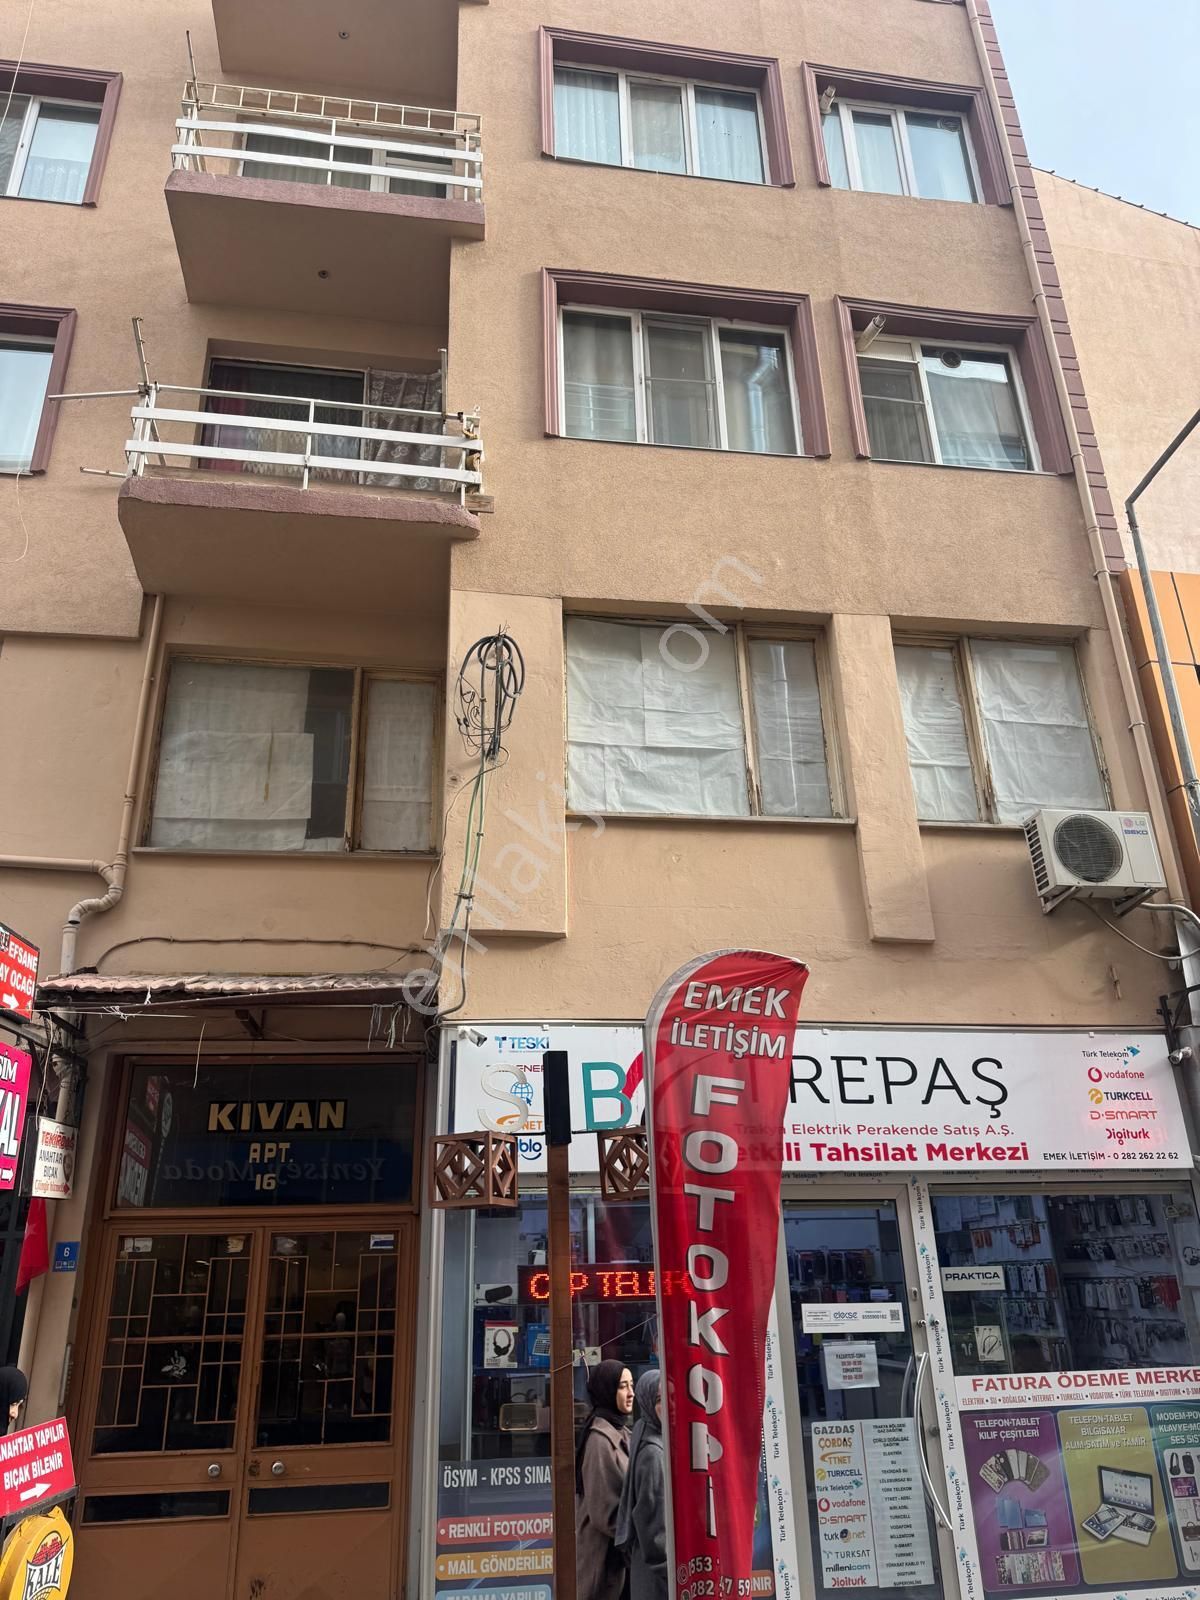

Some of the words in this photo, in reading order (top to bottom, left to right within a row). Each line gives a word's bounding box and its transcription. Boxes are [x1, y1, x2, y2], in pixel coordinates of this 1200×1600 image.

[8, 940, 38, 972] EFSANE
[10, 970, 36, 998] OCAĞI
[683, 980, 792, 1019] EMEK
[670, 1016, 787, 1059] İLETİŞİM
[1082, 1050, 1098, 1058] Türk
[1100, 1050, 1129, 1058] Telekom
[1104, 1070, 1144, 1079] vodafone
[1104, 1092, 1153, 1101] TURKCELL
[207, 1102, 346, 1131] KIVAN
[792, 1124, 850, 1136] Elektrik
[857, 1124, 938, 1136] Perakende
[943, 1124, 980, 1138] Satış
[985, 1124, 1014, 1138] A.Ş.
[1106, 1128, 1150, 1146] Digiturk
[39, 1150, 63, 1164] ANAHTAR
[249, 1142, 295, 1163] APT.
[810, 1142, 918, 1162] Tahsilat
[926, 1142, 1028, 1162] Merkezi
[1043, 1152, 1067, 1160] EMEK
[1069, 1151, 1106, 1161] İLETİŞİM
[1122, 1152, 1137, 1160] 282
[1139, 1152, 1154, 1160] 262
[1156, 1152, 1166, 1160] 22
[1168, 1152, 1178, 1160] 62
[44, 1166, 58, 1180] BIÇAK
[255, 1174, 276, 1191] 16
[916, 1186, 925, 1214] Telekom
[64, 1248, 70, 1257] 6
[924, 1254, 933, 1284] Telekom
[945, 1272, 1000, 1280] PRAKTICA
[682, 1074, 745, 1538] FOTOKOPİ
[934, 1325, 942, 1355] Telekom
[972, 1375, 1052, 1392] FATURA
[1058, 1371, 1130, 1388] ÖDEME
[1136, 1368, 1200, 1385] MERKE
[962, 1397, 985, 1406] ELEKTRİK
[1002, 1395, 1026, 1404] DOĞALGAZ
[1032, 1394, 1054, 1402] İNTERNET
[1090, 1391, 1114, 1400] VODAFONE
[1120, 1389, 1132, 1398] TÜRK
[1133, 1389, 1154, 1398] TELEKOM
[944, 1400, 953, 1431] Telekom
[974, 1417, 1040, 1428] TELEFON-TABLET
[1069, 1413, 1134, 1424] TELEFON-TABLET
[1156, 1411, 1200, 1421] MODEM-PO
[36, 1423, 65, 1448] YAPILIR
[979, 1430, 998, 1440] KILIF
[1000, 1426, 1040, 1442] ÇEŞİTLERİ
[1081, 1424, 1126, 1436] BİLGİSAYAR
[1064, 1439, 1110, 1450] ALIM-SATIM
[1112, 1440, 1120, 1448] ve
[1123, 1436, 1146, 1446] TAMİR
[1170, 1435, 1185, 1444] SES
[4, 1466, 30, 1491] BIÇAK
[32, 1450, 63, 1477] BİLENİR
[444, 1465, 478, 1488] ÖSYM
[490, 1467, 520, 1486] KPSS
[524, 1466, 552, 1484] SINA
[826, 1468, 862, 1478] TURKCELL
[954, 1478, 962, 1510] Telekom
[832, 1499, 866, 1508] vodafone
[448, 1517, 490, 1539] RENKLİ
[494, 1513, 554, 1536] FOTOKOPİ
[824, 1532, 840, 1541] turk
[852, 1530, 866, 1538] net
[448, 1554, 477, 1575] MAİL
[480, 1550, 553, 1574] GÖNDERİLİR
[826, 1563, 870, 1573] millenicom
[25, 1553, 64, 1600] KALE
[501, 1591, 546, 1600] YAPILIR
[738, 1580, 750, 1596] 59
